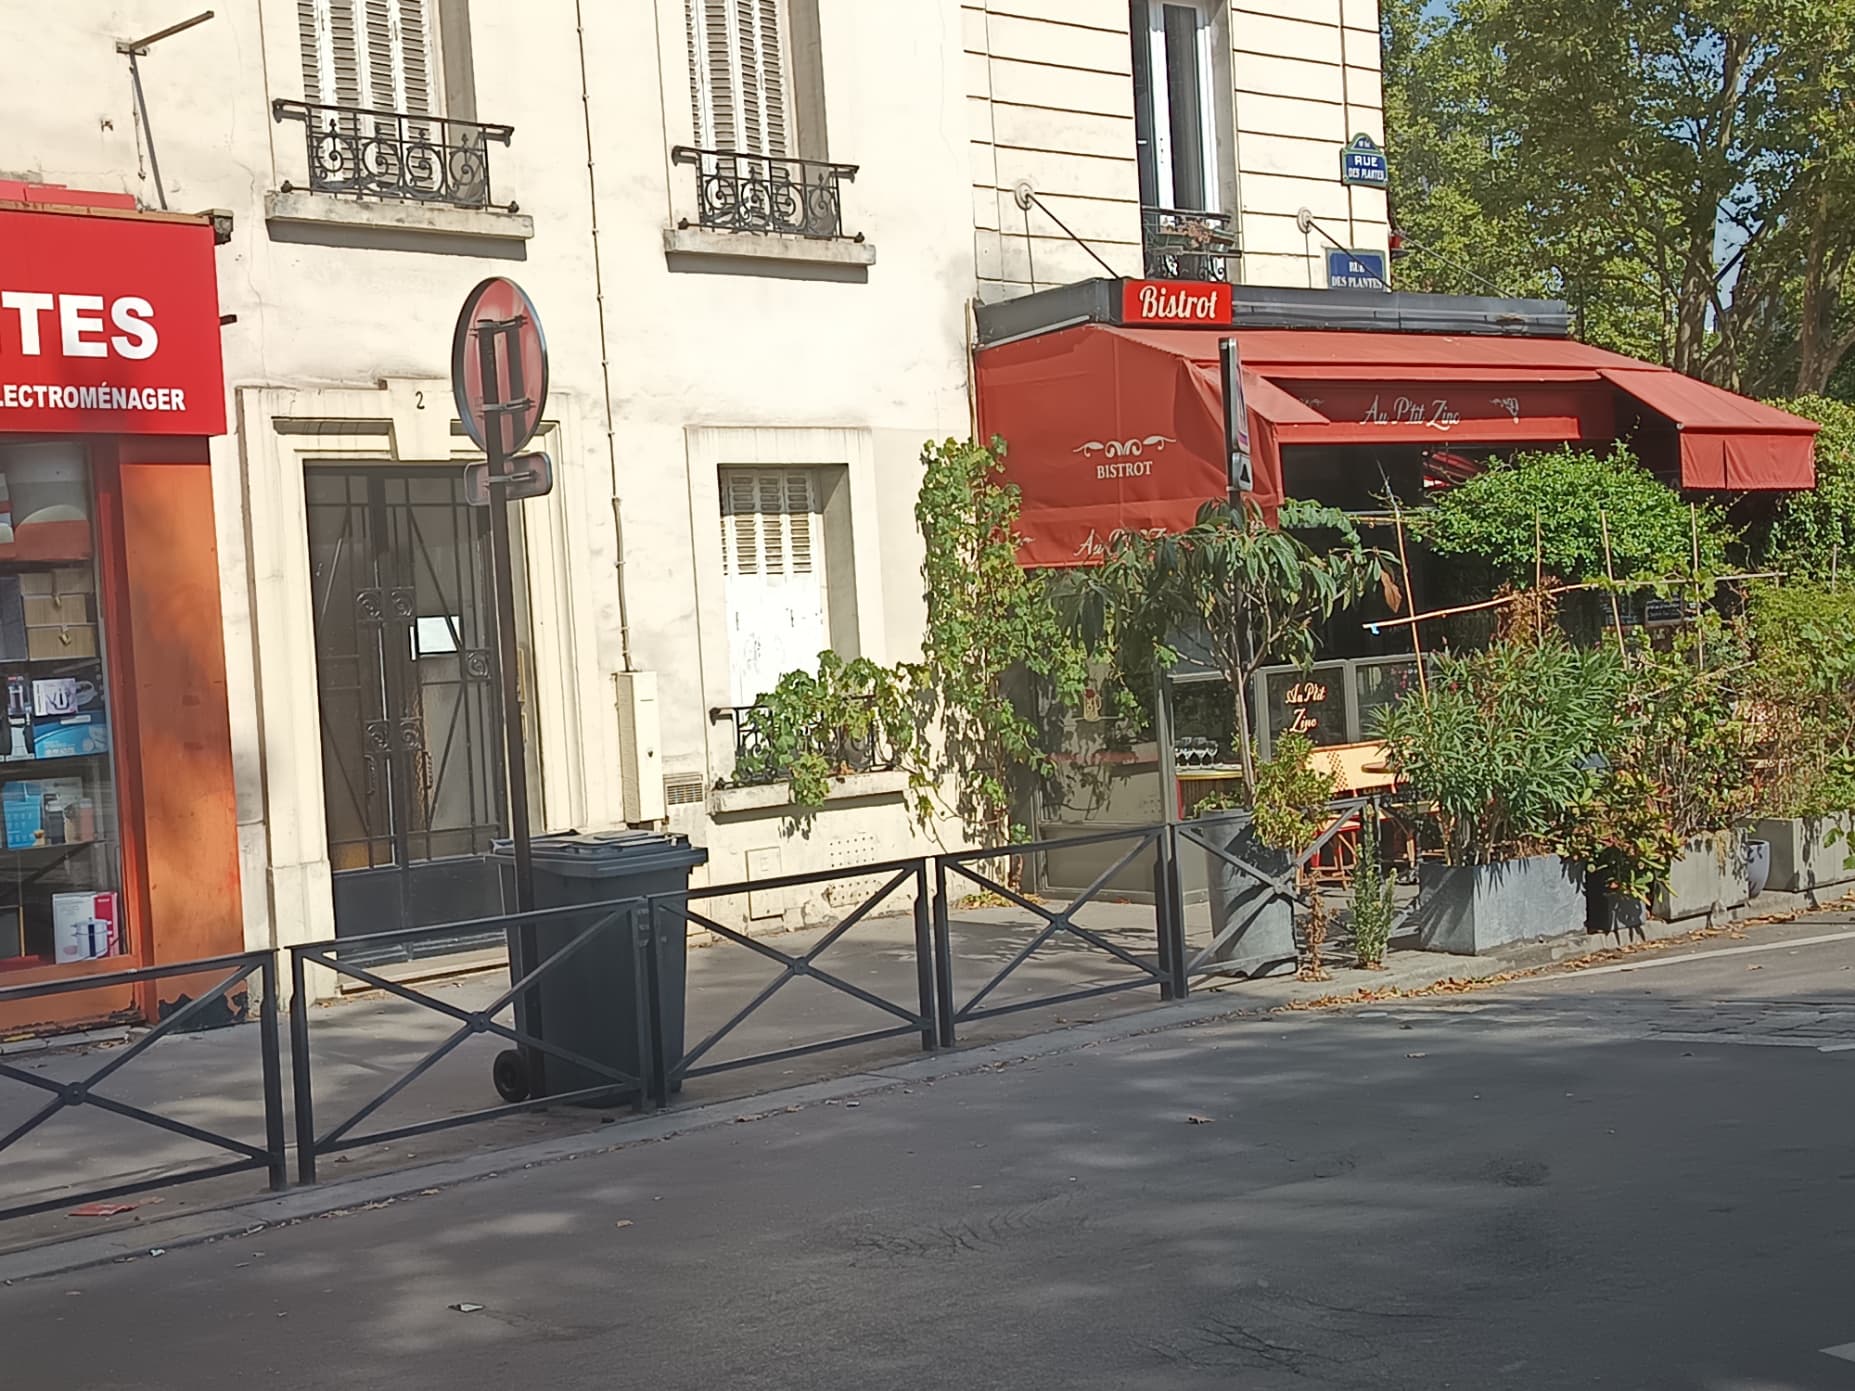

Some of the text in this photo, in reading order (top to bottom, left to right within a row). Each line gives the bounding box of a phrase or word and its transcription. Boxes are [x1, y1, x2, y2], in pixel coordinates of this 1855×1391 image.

[1354, 155, 1378, 167] RUE
[1348, 168, 1385, 181] DES PLANTES
[1332, 275, 1383, 289] DES PLANTES
[1139, 285, 1217, 319] Bistrot
[1, 291, 158, 360] TES
[415, 390, 425, 410] 2
[1360, 394, 1460, 432] Au P'tit Zinc
[1097, 461, 1153, 479] BISTROT
[1073, 528, 1104, 556] Au
